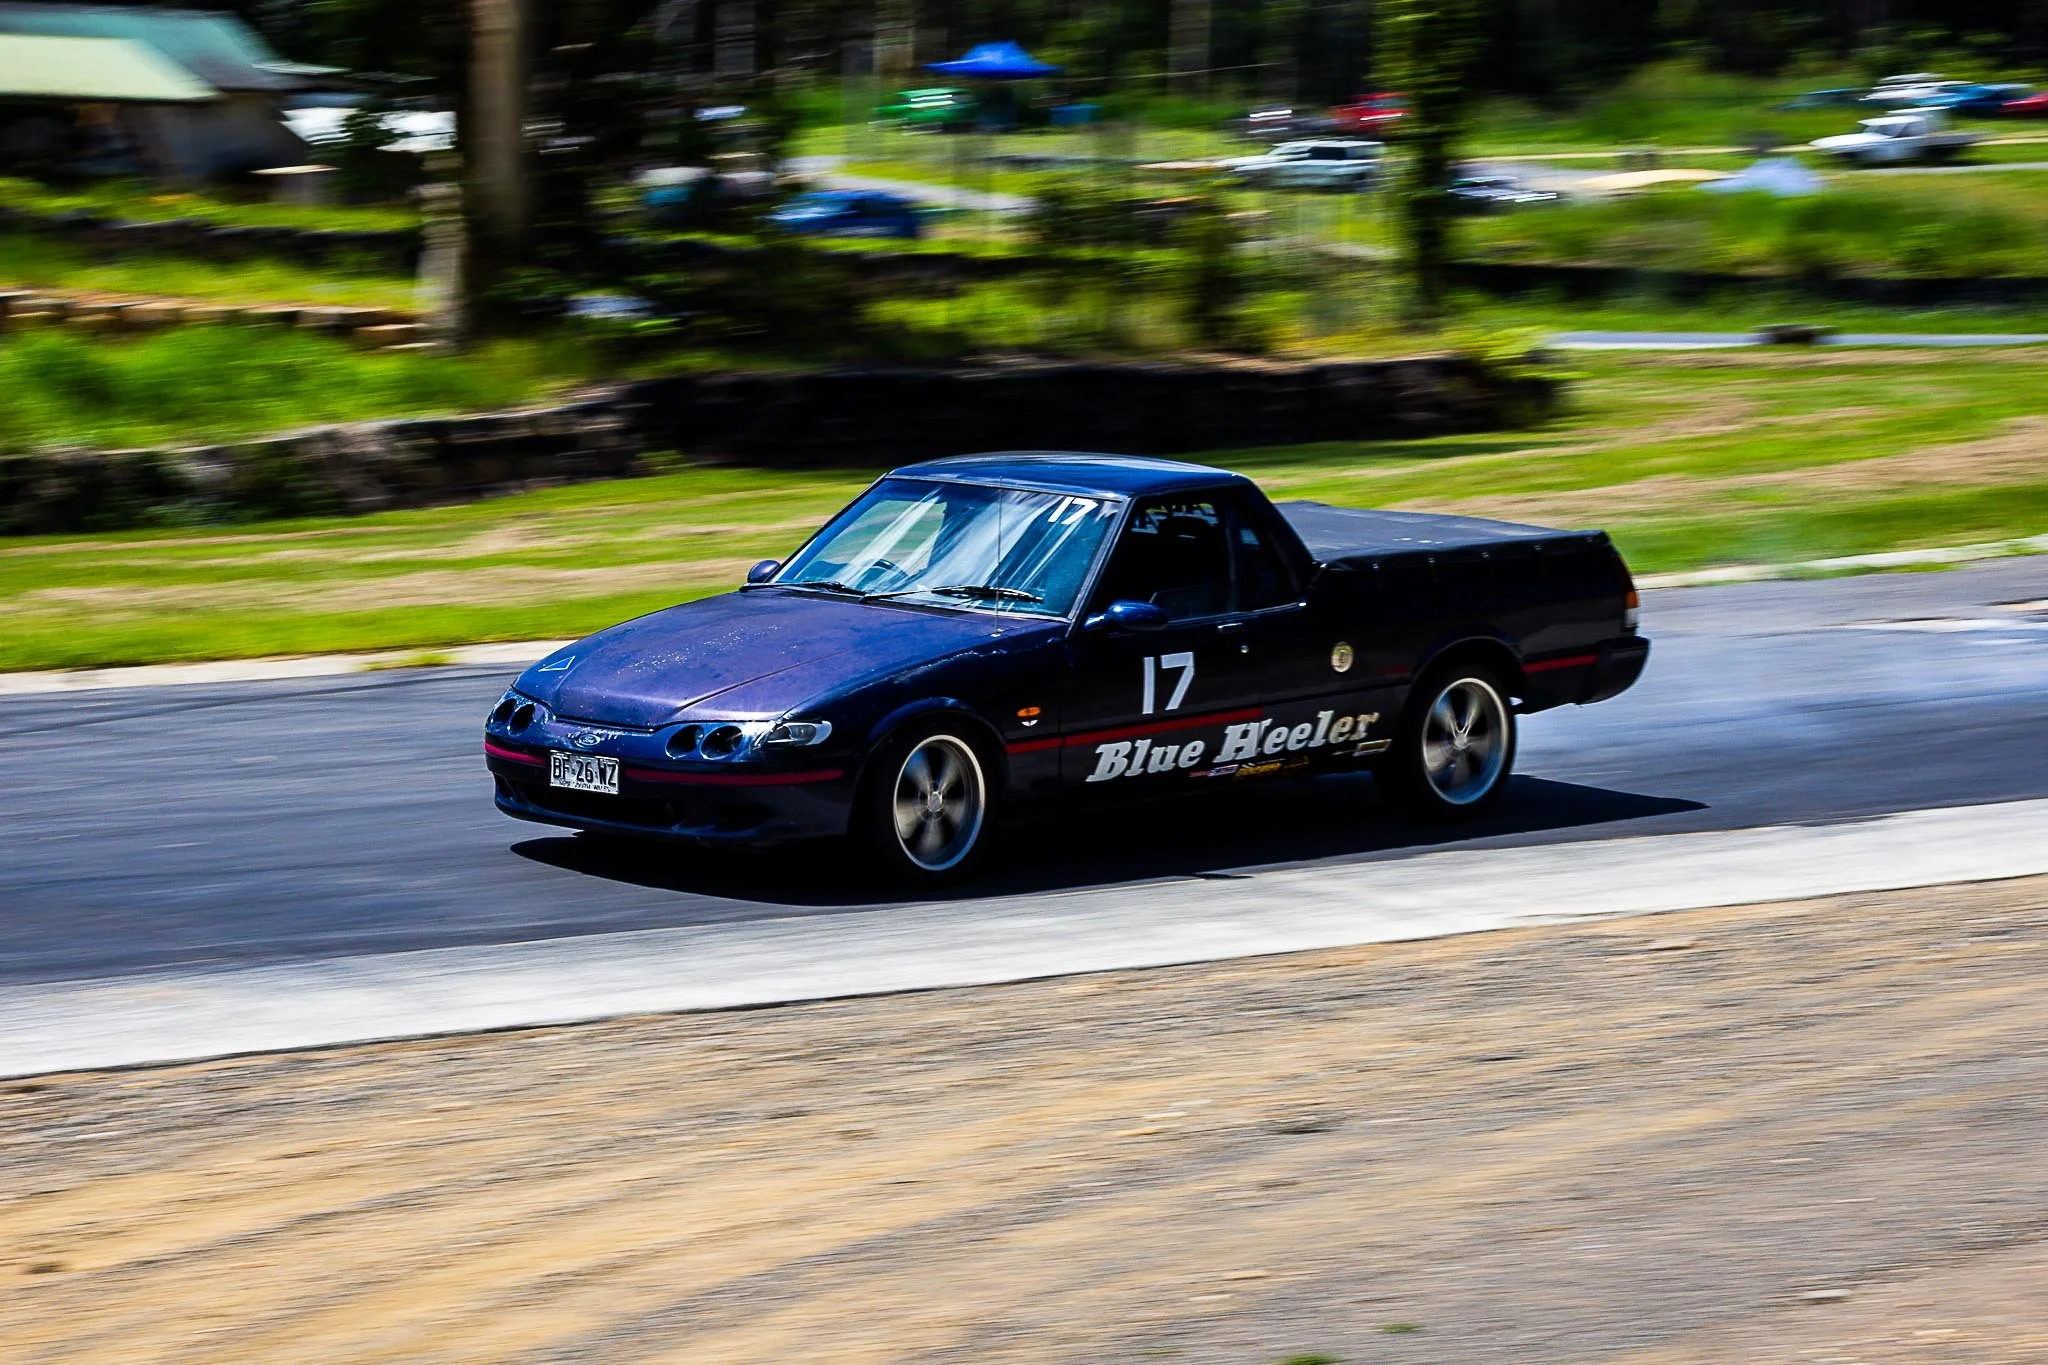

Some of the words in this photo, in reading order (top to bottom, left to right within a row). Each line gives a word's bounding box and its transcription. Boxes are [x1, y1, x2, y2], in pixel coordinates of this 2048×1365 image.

[1047, 496, 1099, 525] 17
[1141, 652, 1195, 714] 17
[1085, 738, 1205, 782] Blue
[1212, 710, 1380, 763] Heeler
[576, 760, 594, 783] 26
